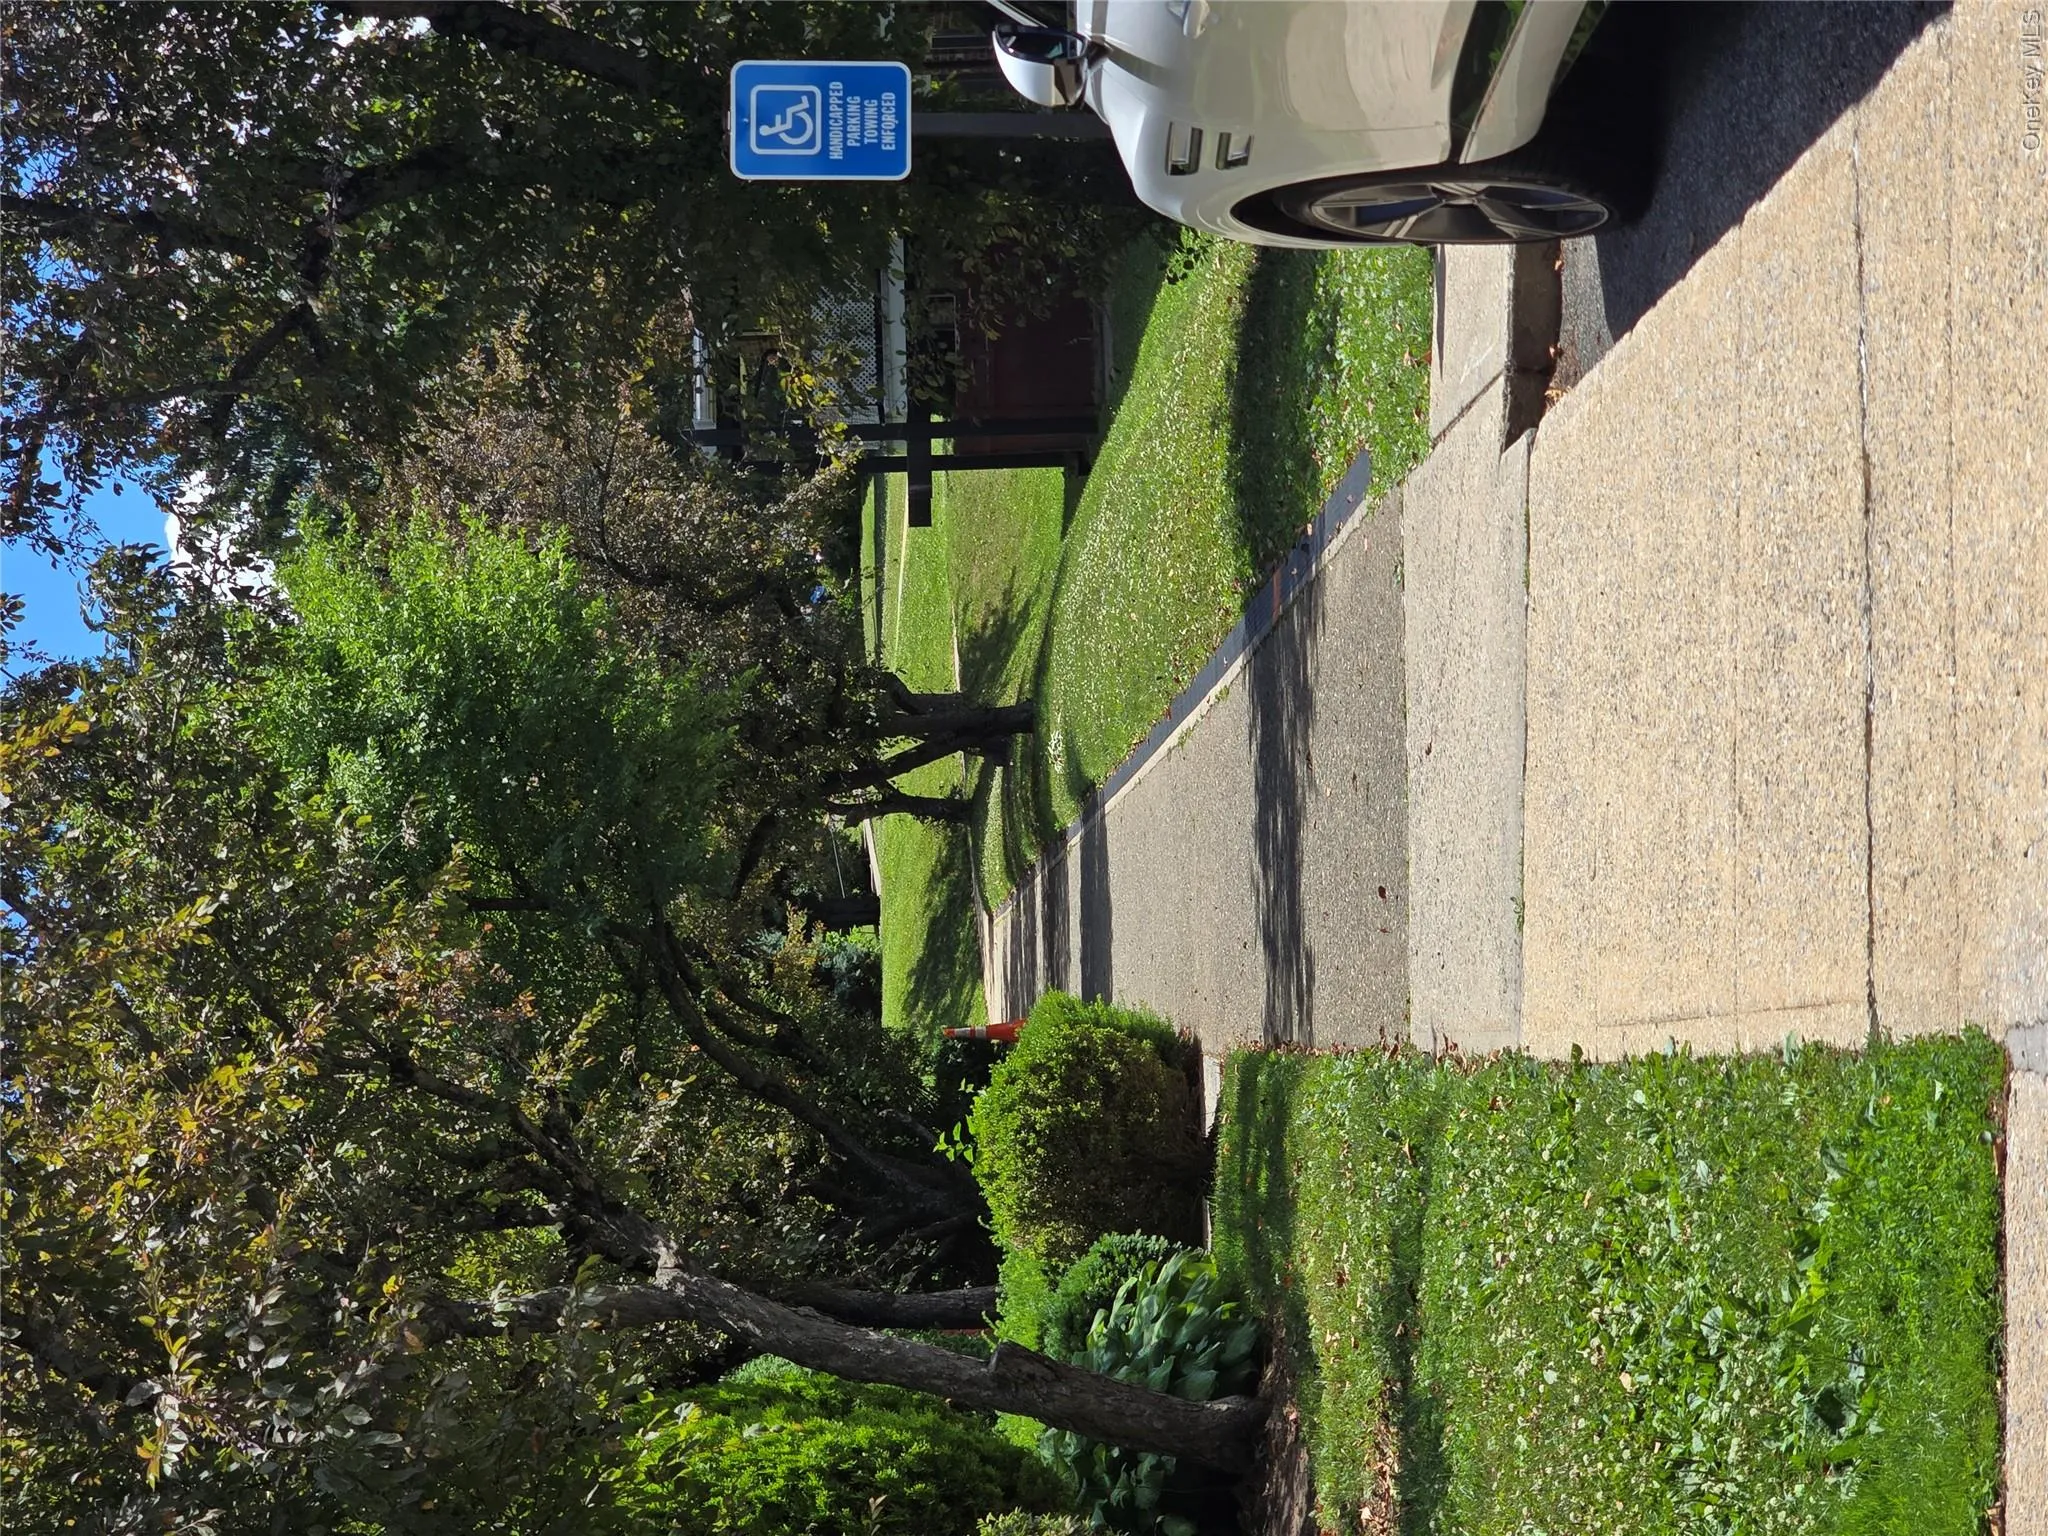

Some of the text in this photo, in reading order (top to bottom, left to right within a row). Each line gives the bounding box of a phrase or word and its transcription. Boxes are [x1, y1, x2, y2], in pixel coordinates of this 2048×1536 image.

[829, 81, 844, 160] HANDICAPPED
[846, 95, 861, 147] PARKING
[863, 99, 879, 145] TOWING
[881, 91, 896, 151] ENFORCED
